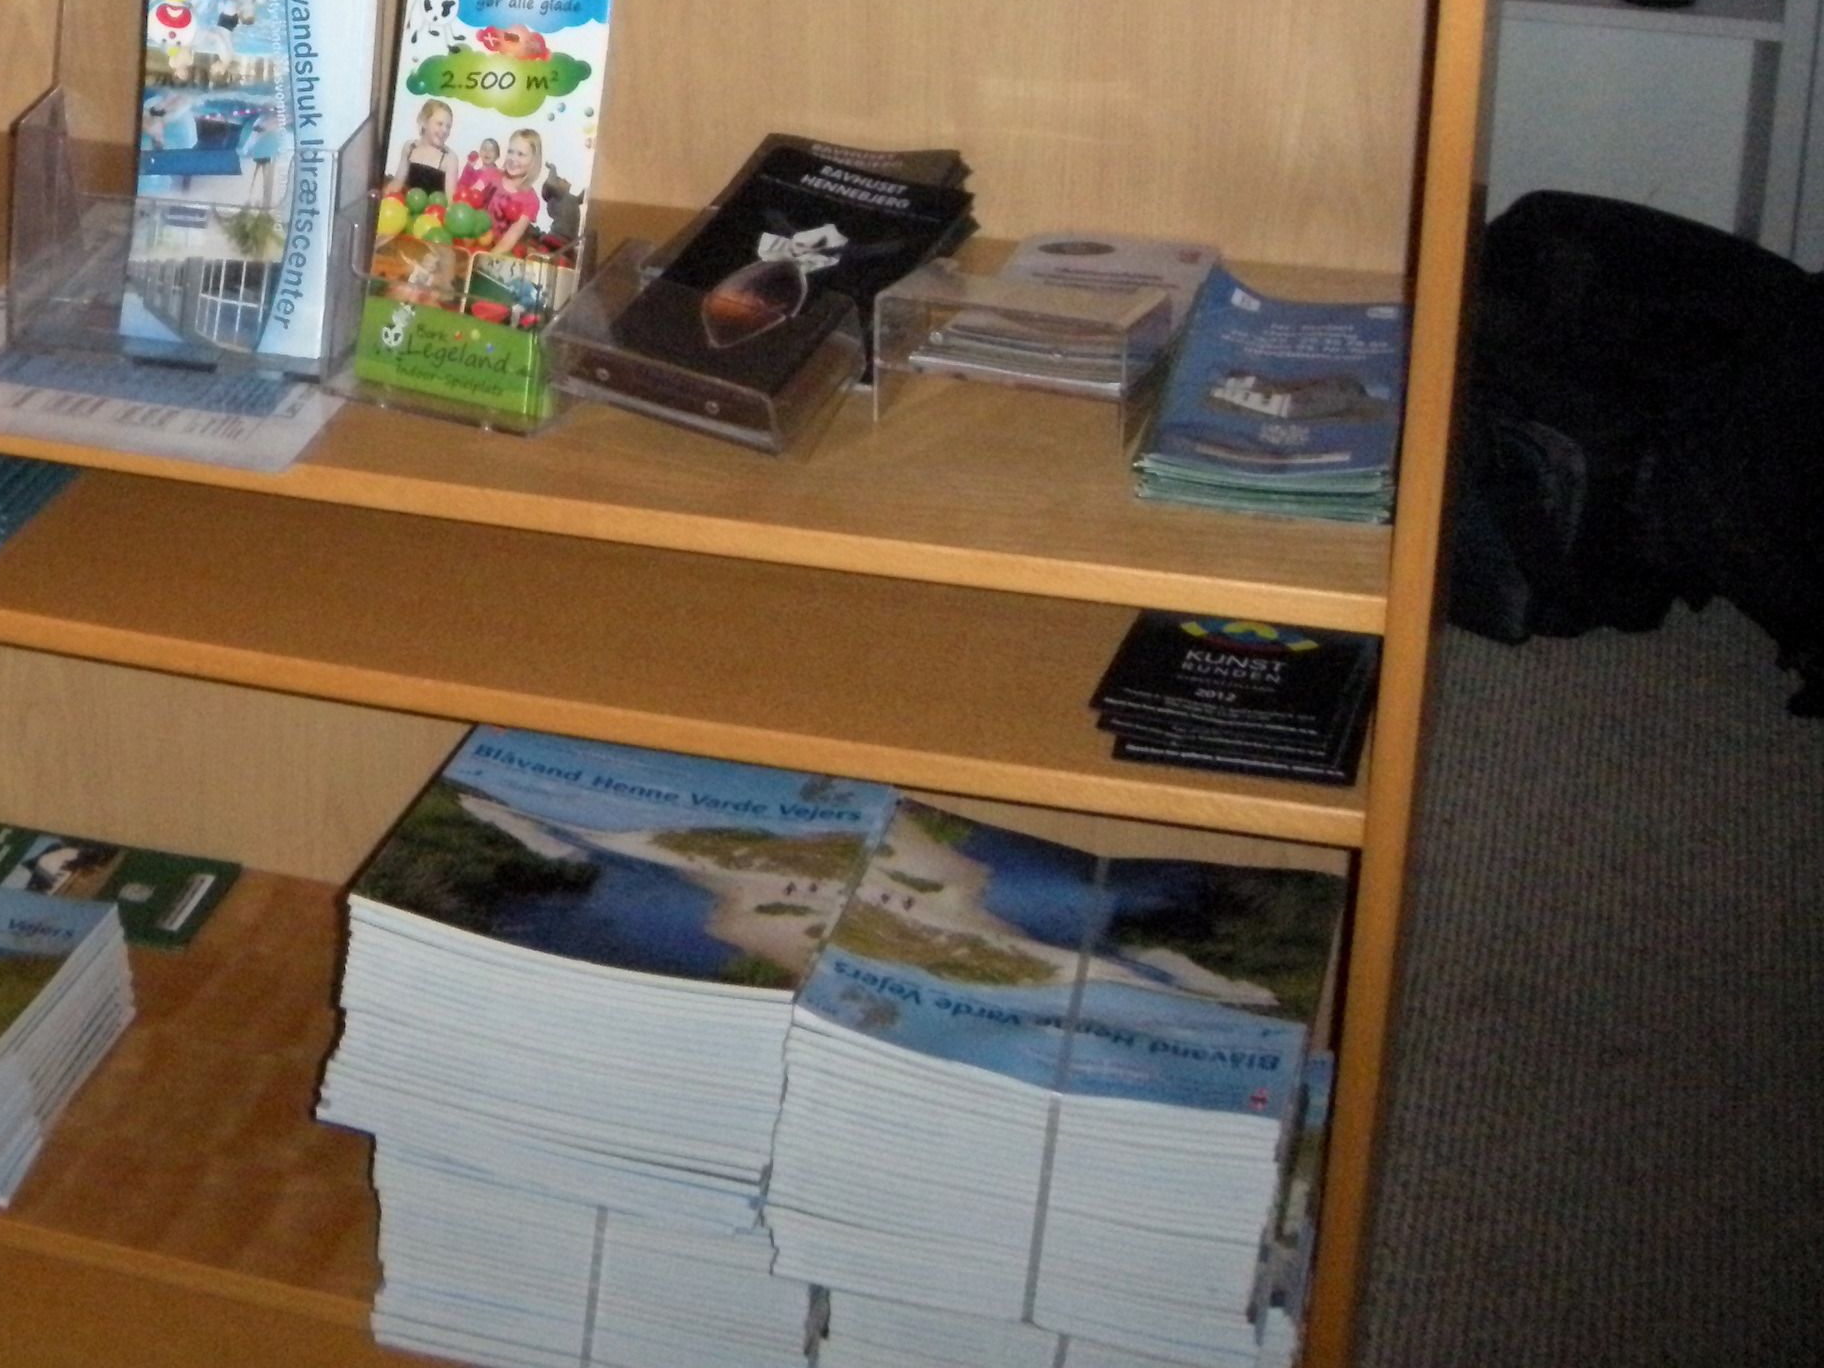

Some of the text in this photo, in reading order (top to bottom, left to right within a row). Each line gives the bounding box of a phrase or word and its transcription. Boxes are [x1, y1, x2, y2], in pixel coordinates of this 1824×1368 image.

[439, 70, 517, 91] 2.500
[800, 173, 910, 209] HENNEBJERG
[820, 165, 908, 195] RAVHUSET
[274, 137, 324, 331] Idrætscenter
[1181, 661, 1281, 684] RUNDEN
[1186, 650, 1287, 672] KUNST
[473, 743, 581, 782] Blåvand
[591, 774, 680, 803] Henne
[690, 792, 769, 816] Varde
[778, 803, 863, 822] Vejers
